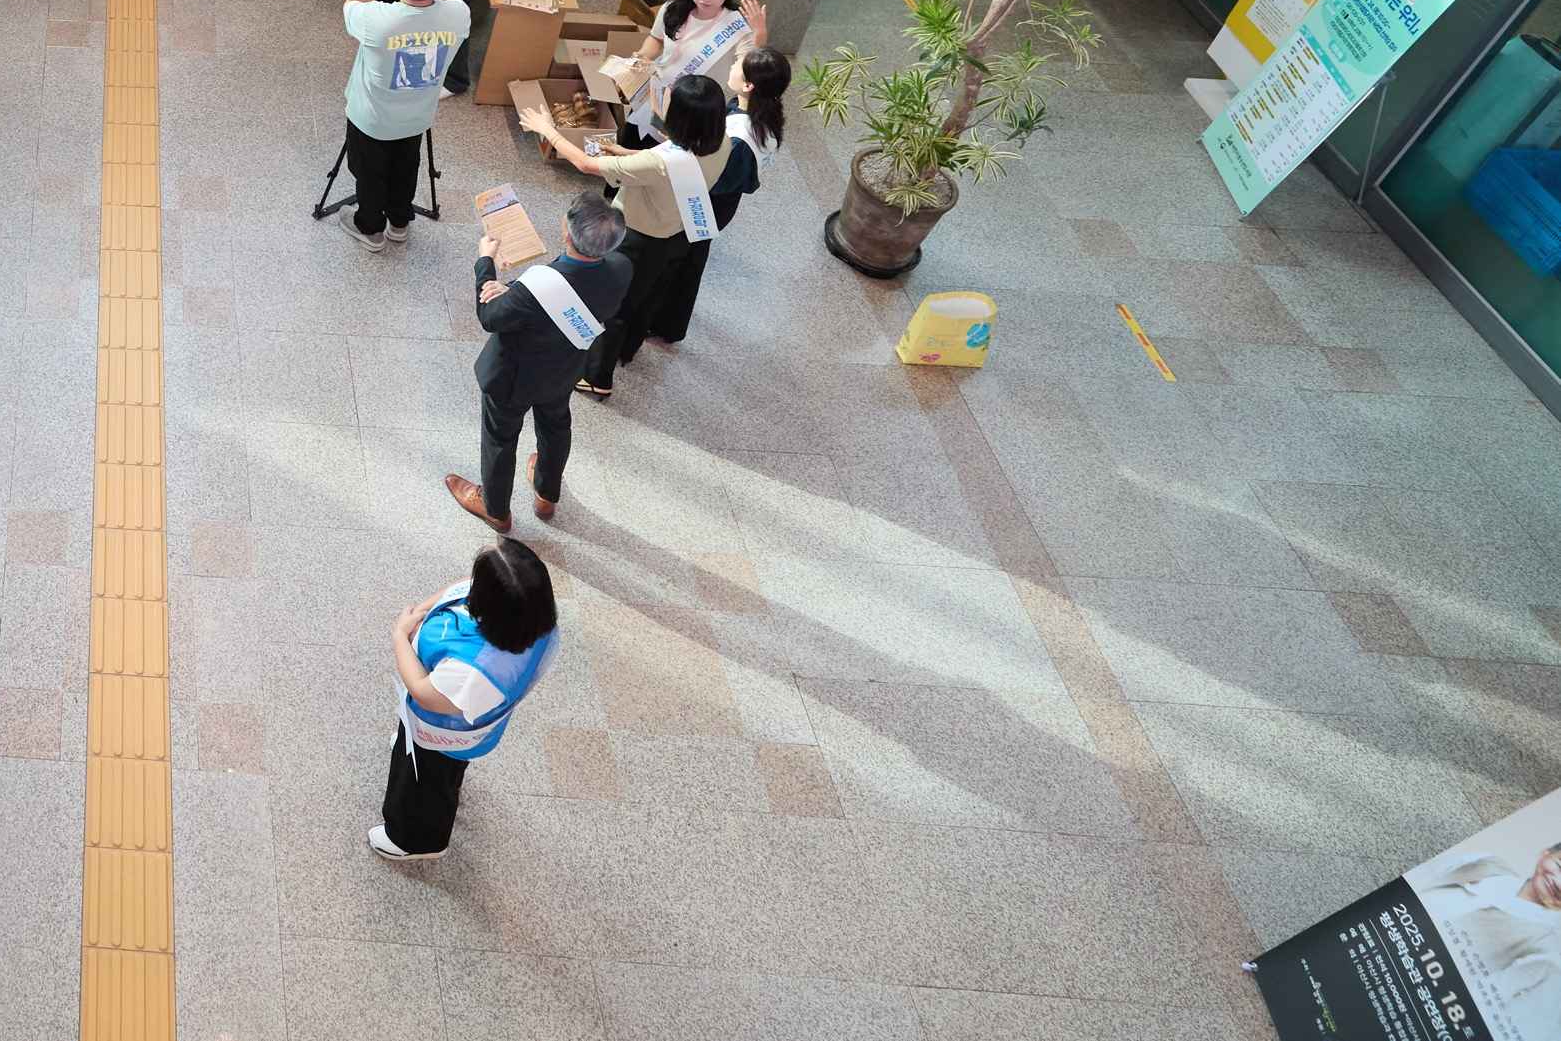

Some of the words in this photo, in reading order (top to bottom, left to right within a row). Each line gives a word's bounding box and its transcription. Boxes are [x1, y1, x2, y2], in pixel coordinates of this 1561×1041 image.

[386, 31, 457, 50] BEYOND
[1377, 908, 1424, 987] 평생학습관
[1392, 900, 1428, 954] 2025.
[1417, 947, 1449, 988] 10.
[1439, 989, 1470, 1031] 18.
[1355, 964, 1371, 990] 아산시
[1364, 959, 1381, 986] 아산시
[1374, 954, 1388, 973] 전석
[1382, 972, 1407, 1014] 10,000원
